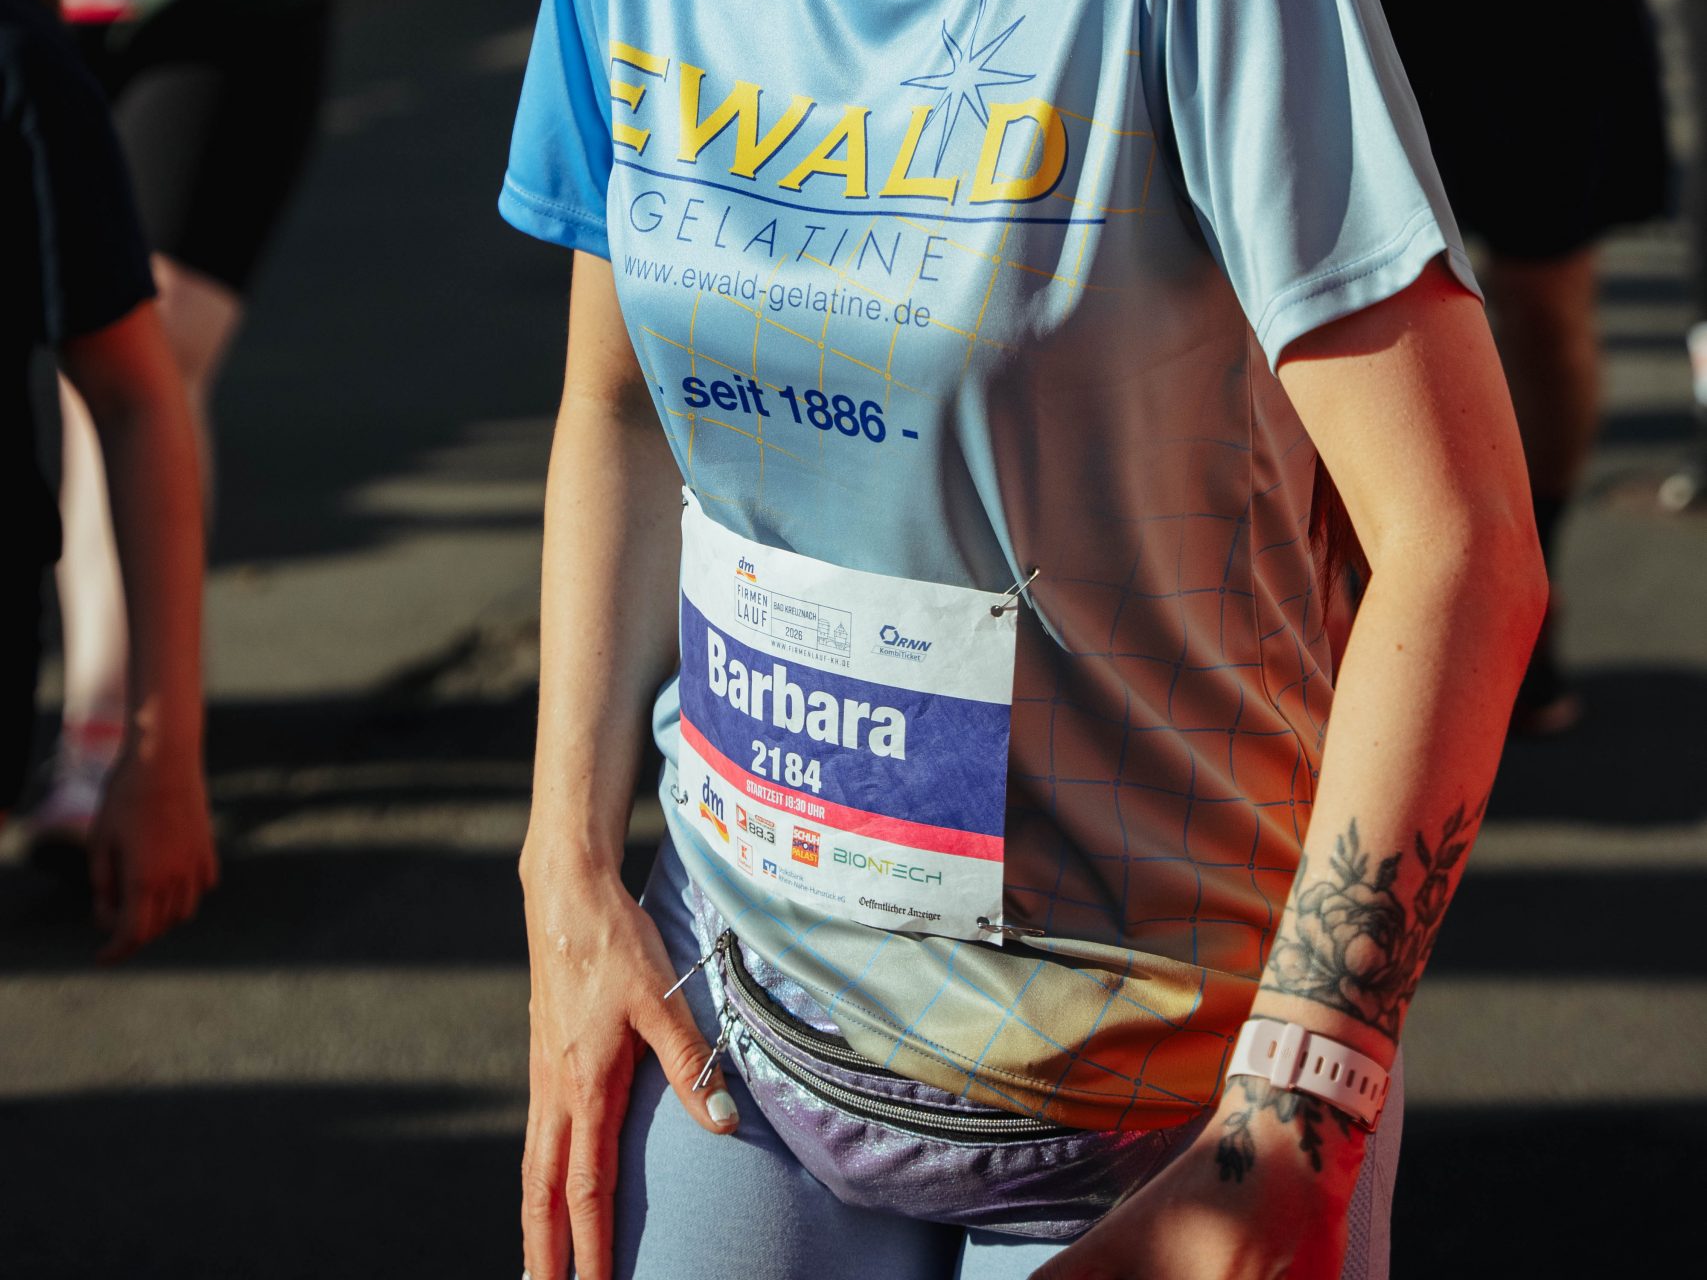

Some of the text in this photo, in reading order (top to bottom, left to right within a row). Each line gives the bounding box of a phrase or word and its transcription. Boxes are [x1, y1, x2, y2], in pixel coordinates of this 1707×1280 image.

[609, 40, 1069, 206] EWALD
[629, 191, 948, 282] GELATINE
[624, 255, 930, 327] www.ewald-gelatine.de
[682, 374, 770, 417] seit
[779, 385, 886, 443] 1886
[738, 556, 755, 573] dm
[737, 584, 768, 608] FIRMEN
[737, 600, 768, 627] LAUF
[773, 601, 817, 621] BAD KREUZNACH
[785, 626, 803, 640] 2026
[707, 626, 906, 760] Barbara
[751, 740, 822, 794] 2184
[702, 775, 724, 820] dm
[746, 779, 825, 819] STARTZEIT 18:30 UHR
[748, 822, 775, 844] 88.3
[792, 847, 818, 863] PALAST
[833, 847, 942, 885] BIONTECH
[858, 896, 942, 921] Oeffentlicher Anzeiger
